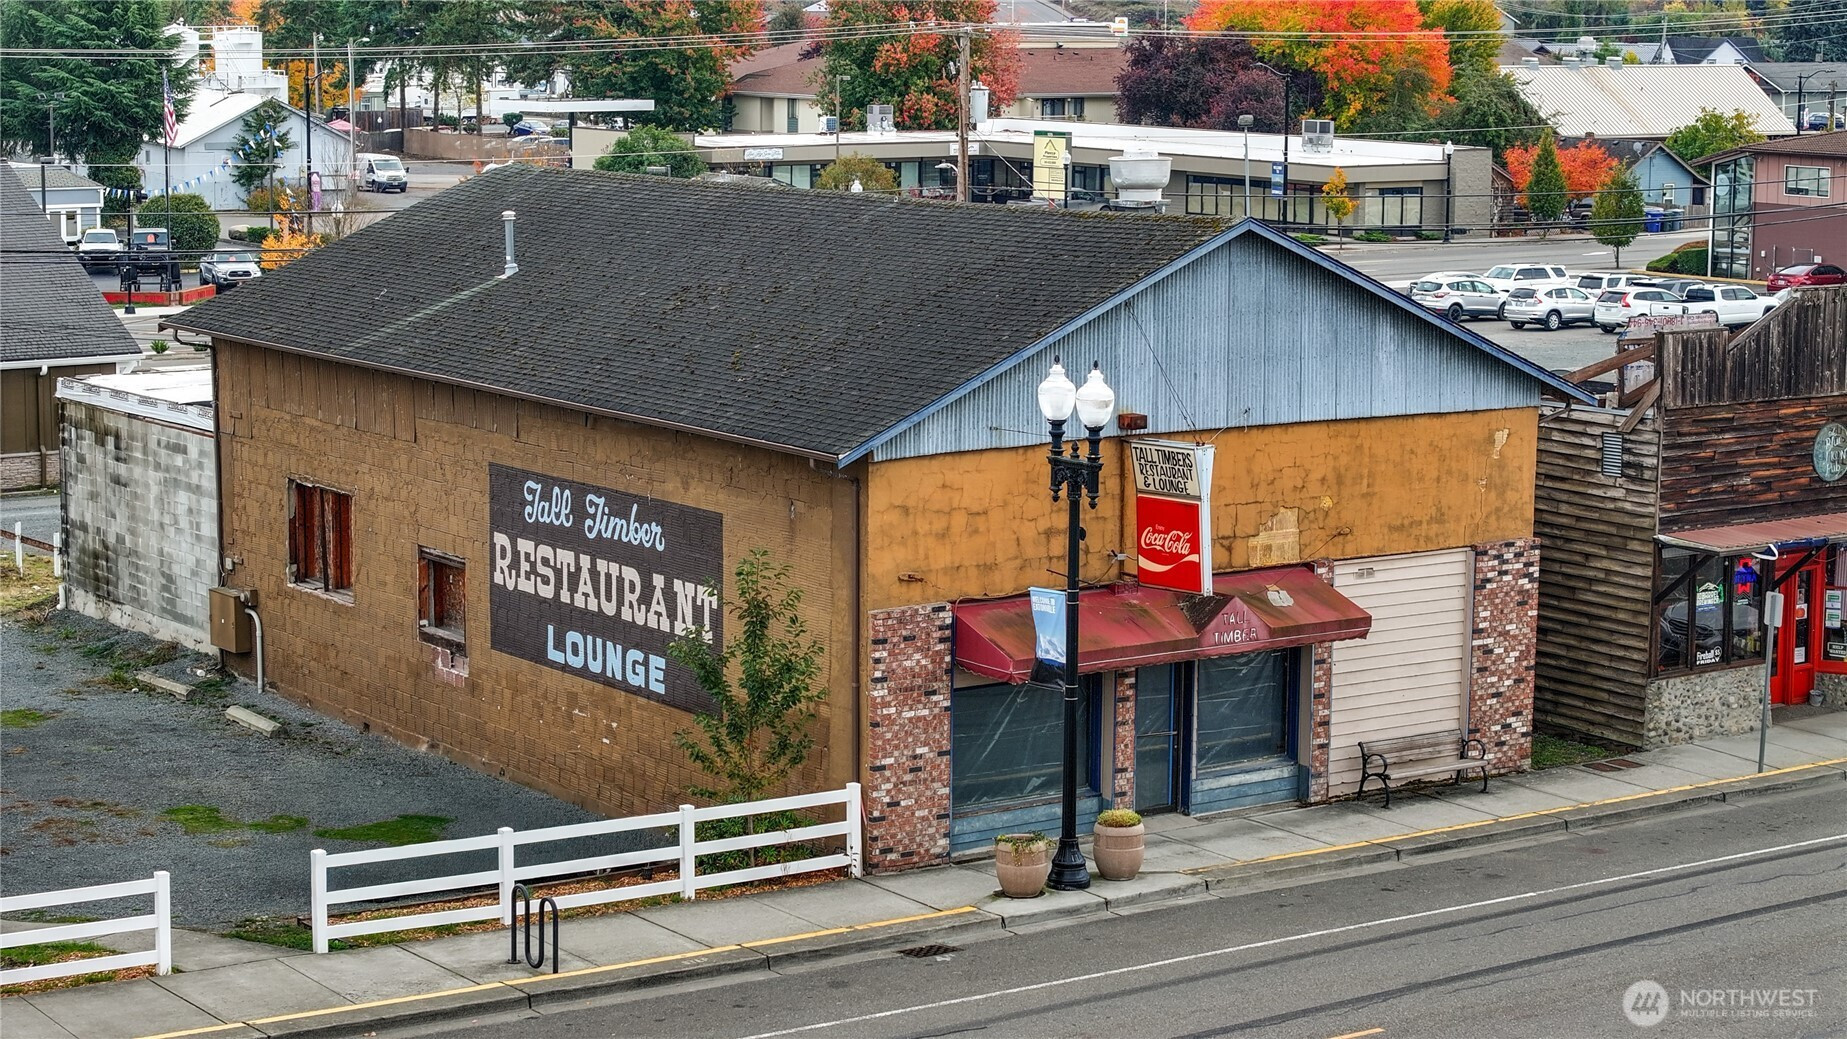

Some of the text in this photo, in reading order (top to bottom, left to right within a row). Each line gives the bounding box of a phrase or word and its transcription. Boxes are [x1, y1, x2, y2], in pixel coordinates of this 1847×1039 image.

[1132, 446, 1193, 468] TALL TIMBERS
[1138, 462, 1194, 482] RESTAURANT
[1143, 476, 1191, 495] & LOUNGE
[523, 480, 665, 551] Tall Timber
[493, 531, 718, 644] RESTAURANT
[547, 624, 666, 694] LOUNGE
[1696, 657, 1720, 665] FRIDAY
